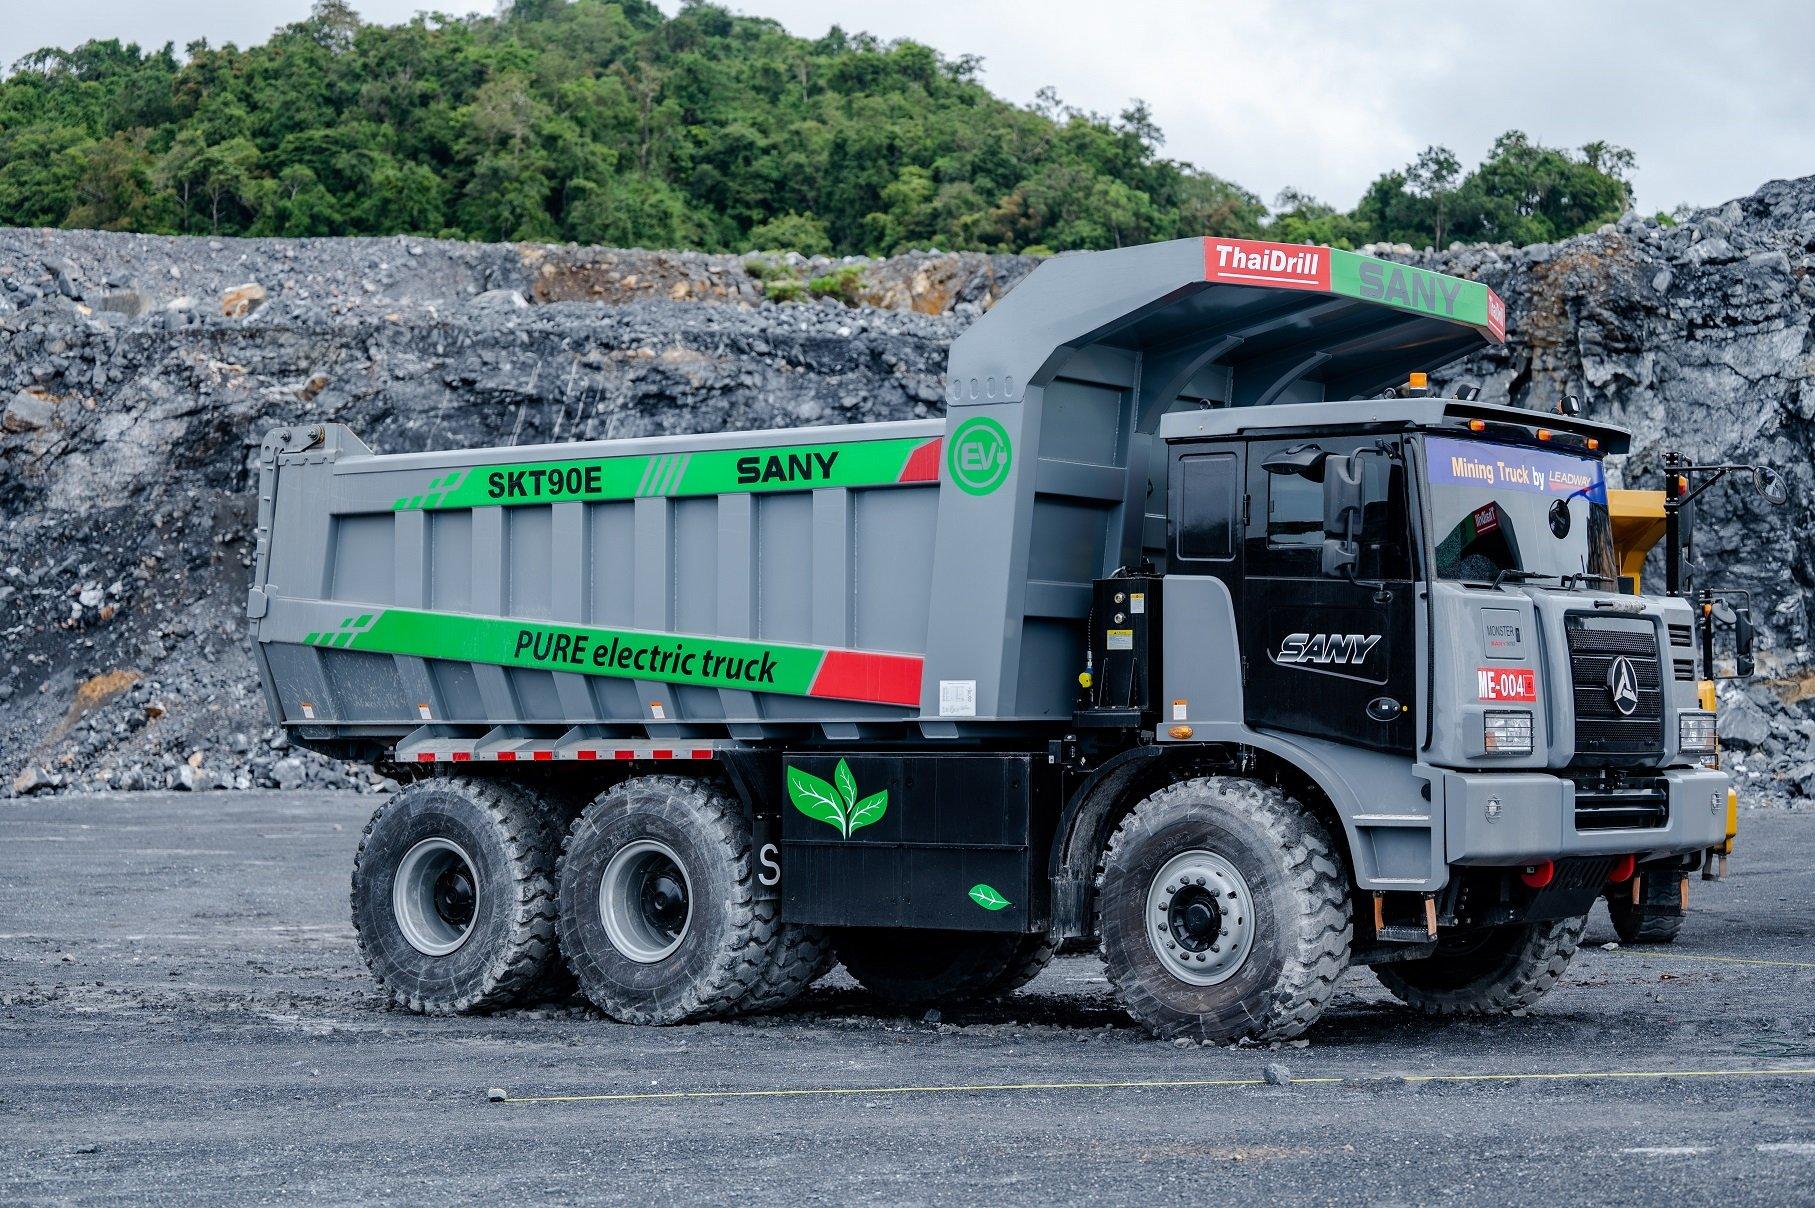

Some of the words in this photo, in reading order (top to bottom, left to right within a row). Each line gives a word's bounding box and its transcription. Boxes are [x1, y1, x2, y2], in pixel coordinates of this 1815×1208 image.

[1216, 244, 1319, 276] ThaiDrill
[1358, 261, 1463, 314] SANY
[736, 451, 840, 485] SANY
[960, 441, 998, 471] EV
[487, 465, 603, 499] SKT90E
[1452, 457, 1493, 484] Mining
[1497, 461, 1530, 485] Truck
[1532, 466, 1545, 491] by
[1548, 469, 1592, 487] LEADWAY
[1486, 625, 1515, 637] MONSTER
[514, 629, 588, 666] PURE
[592, 636, 696, 677] electric
[702, 649, 779, 684] truck
[1276, 632, 1383, 664] SANY
[1477, 670, 1524, 700] ME-004
